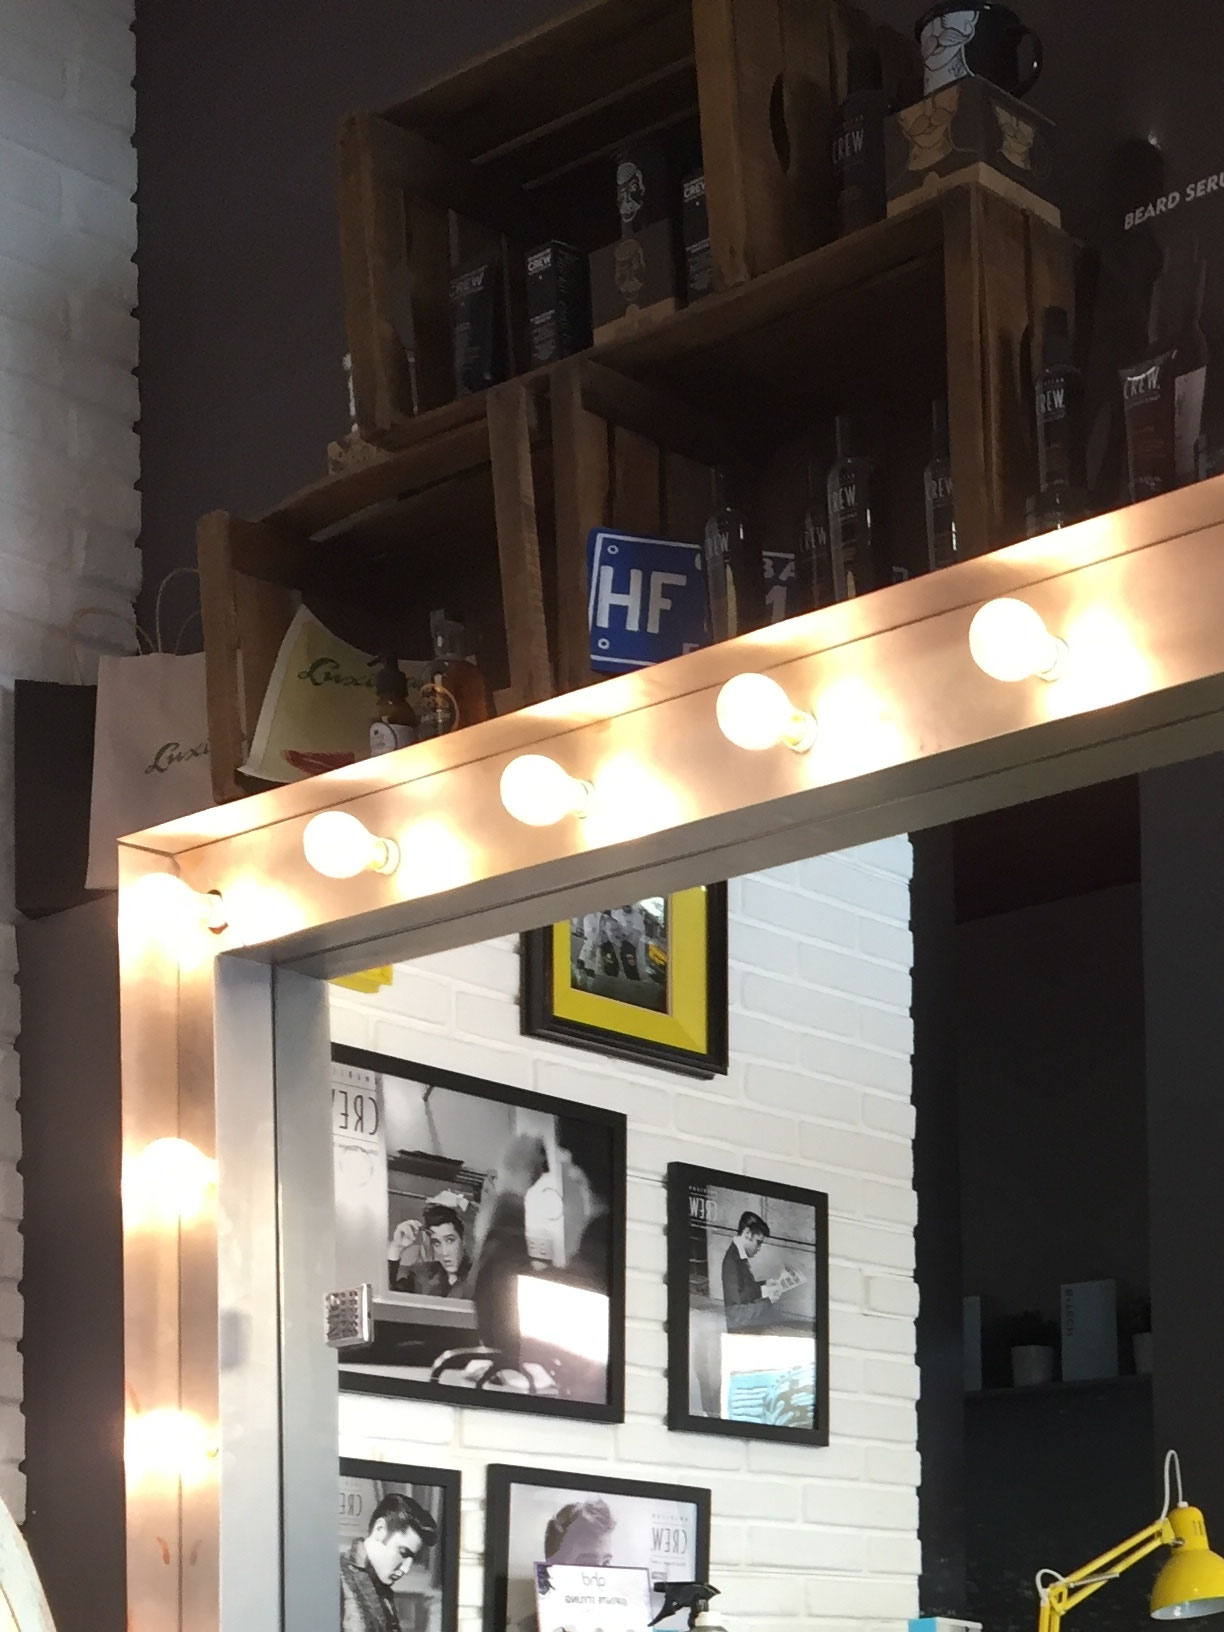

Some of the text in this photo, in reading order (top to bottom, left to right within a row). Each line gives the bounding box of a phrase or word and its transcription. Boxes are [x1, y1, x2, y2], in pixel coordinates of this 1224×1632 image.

[832, 127, 864, 165] CREW
[1124, 191, 1181, 231] BEARD
[527, 252, 552, 273] CREW
[1037, 388, 1066, 414] REW
[1124, 364, 1161, 401] CREW
[596, 563, 687, 635] HF
